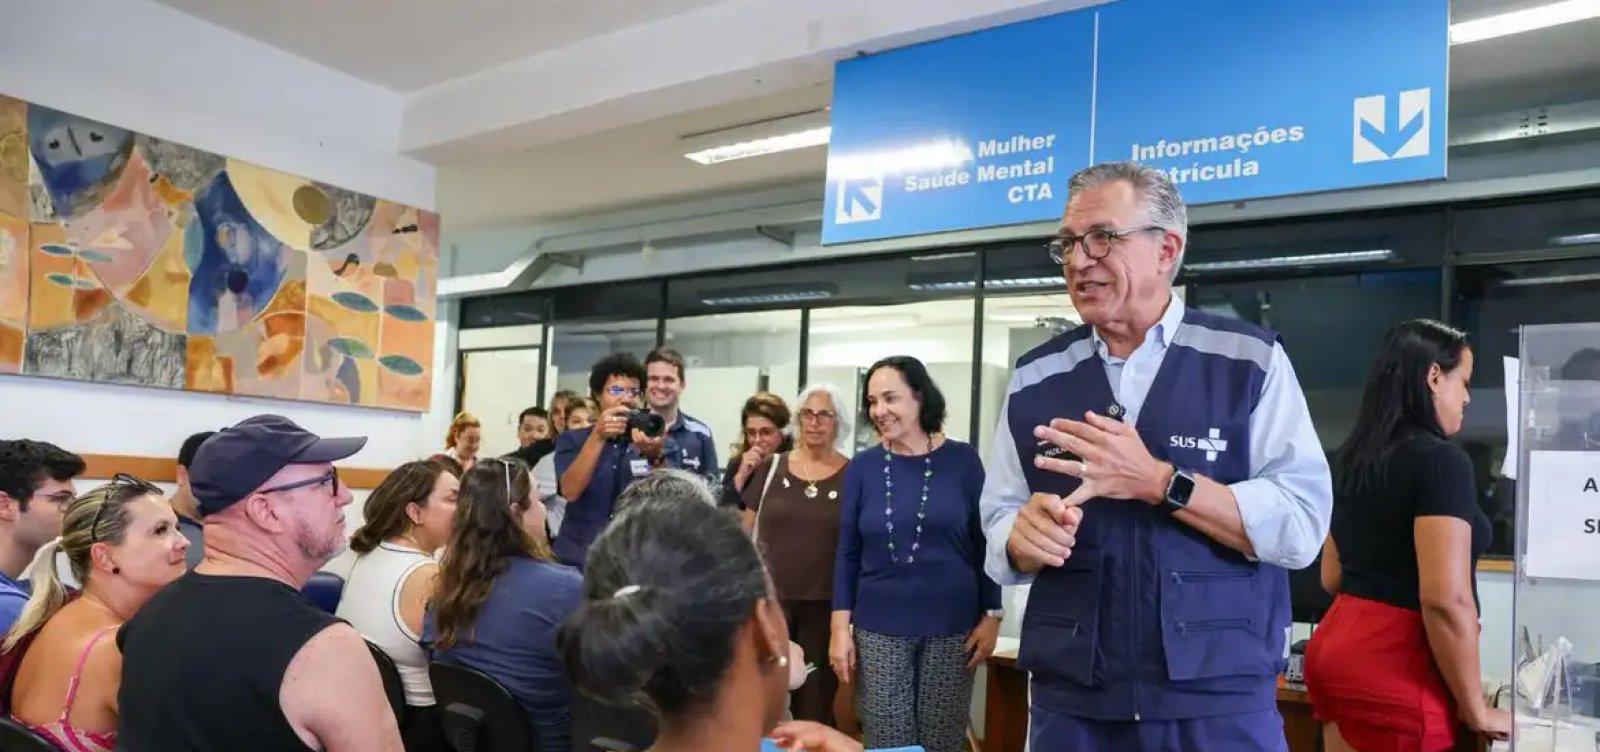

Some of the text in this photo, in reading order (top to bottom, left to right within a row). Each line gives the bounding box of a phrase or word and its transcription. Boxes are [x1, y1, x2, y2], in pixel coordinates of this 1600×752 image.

[978, 133, 1056, 157] Mulher
[1131, 125, 1305, 161] Informações
[904, 156, 1054, 192] Saúde Mental
[1007, 182, 1053, 203] CTA
[1169, 435, 1196, 448] SUS
[1583, 477, 1599, 492] A
[1584, 518, 1600, 534] S
